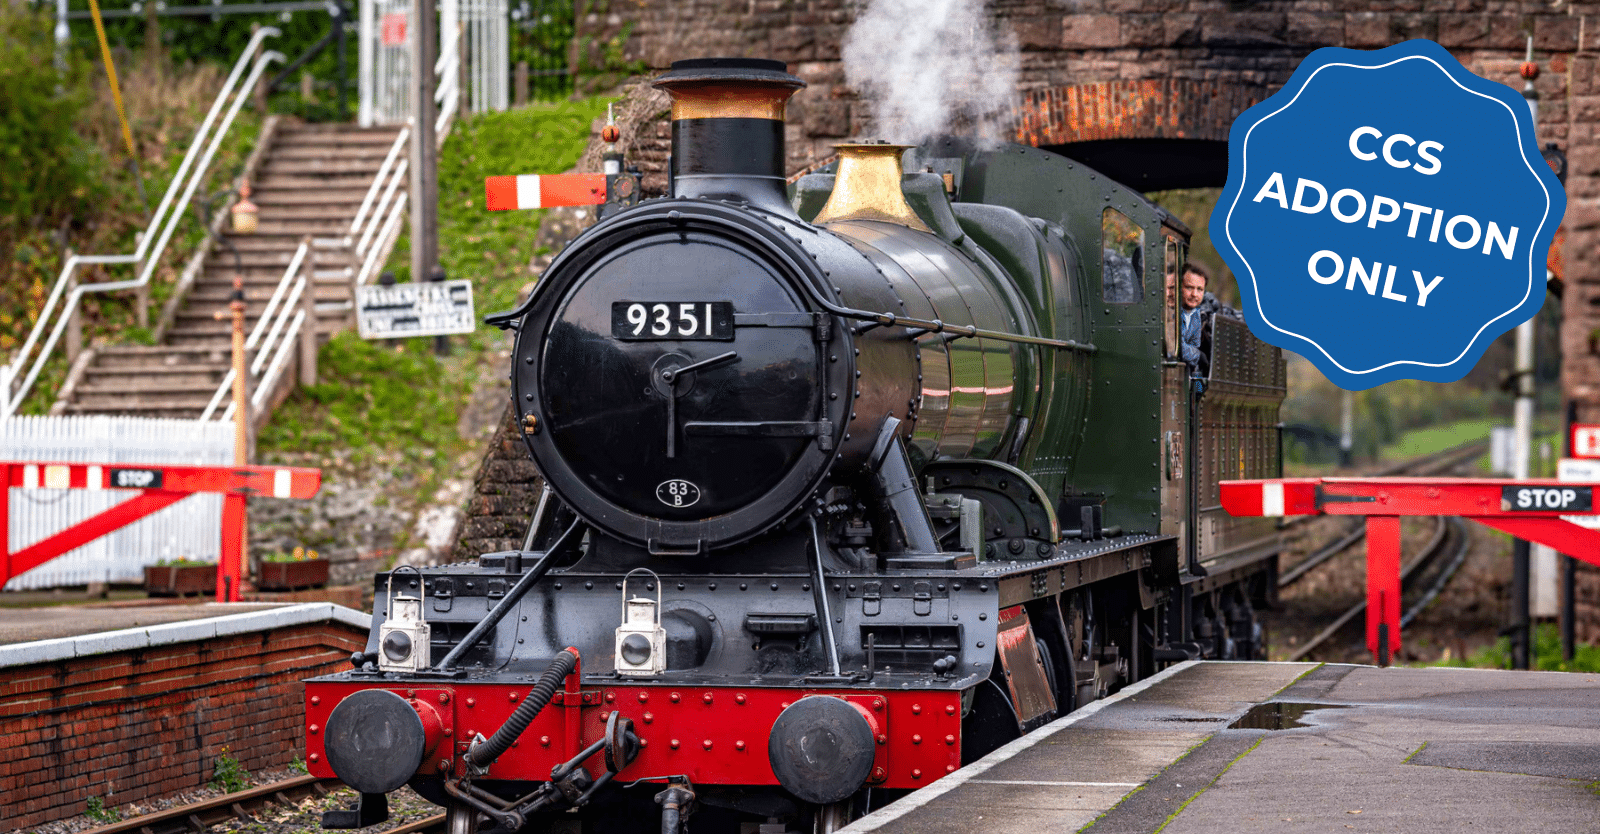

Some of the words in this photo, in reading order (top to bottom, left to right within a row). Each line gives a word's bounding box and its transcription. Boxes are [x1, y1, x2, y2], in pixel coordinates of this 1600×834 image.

[626, 303, 713, 337] 9351
[117, 469, 154, 487] STOP
[668, 481, 688, 496] 83
[674, 494, 683, 506] B
[1516, 488, 1577, 508] STOP
